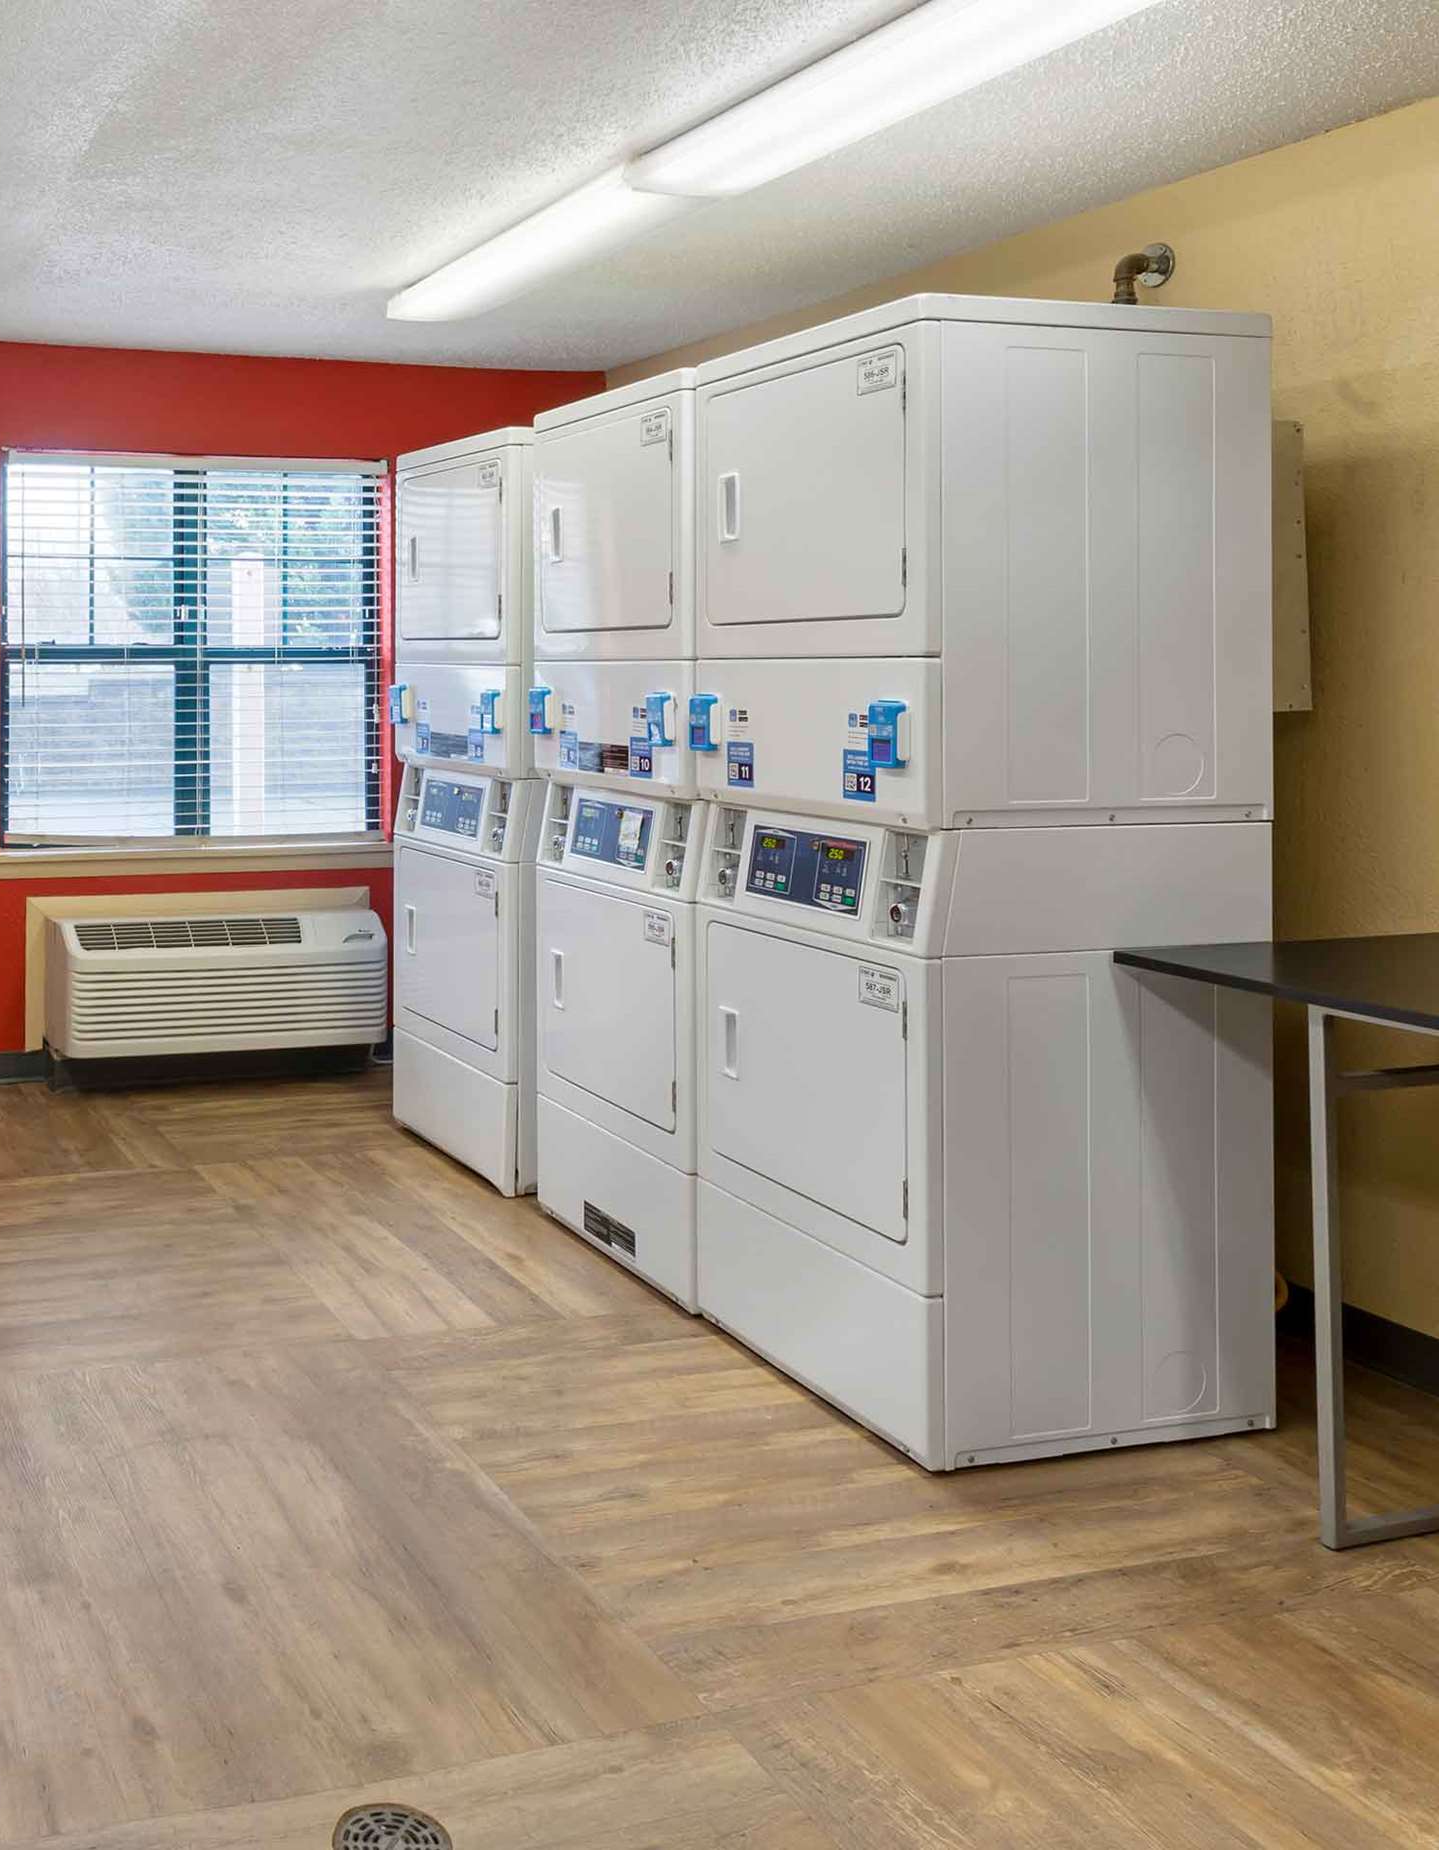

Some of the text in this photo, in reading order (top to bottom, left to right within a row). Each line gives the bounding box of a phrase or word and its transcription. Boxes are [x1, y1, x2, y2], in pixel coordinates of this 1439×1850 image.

[640, 758, 650, 771] 10
[741, 766, 750, 779] 11
[858, 776, 872, 792] 12
